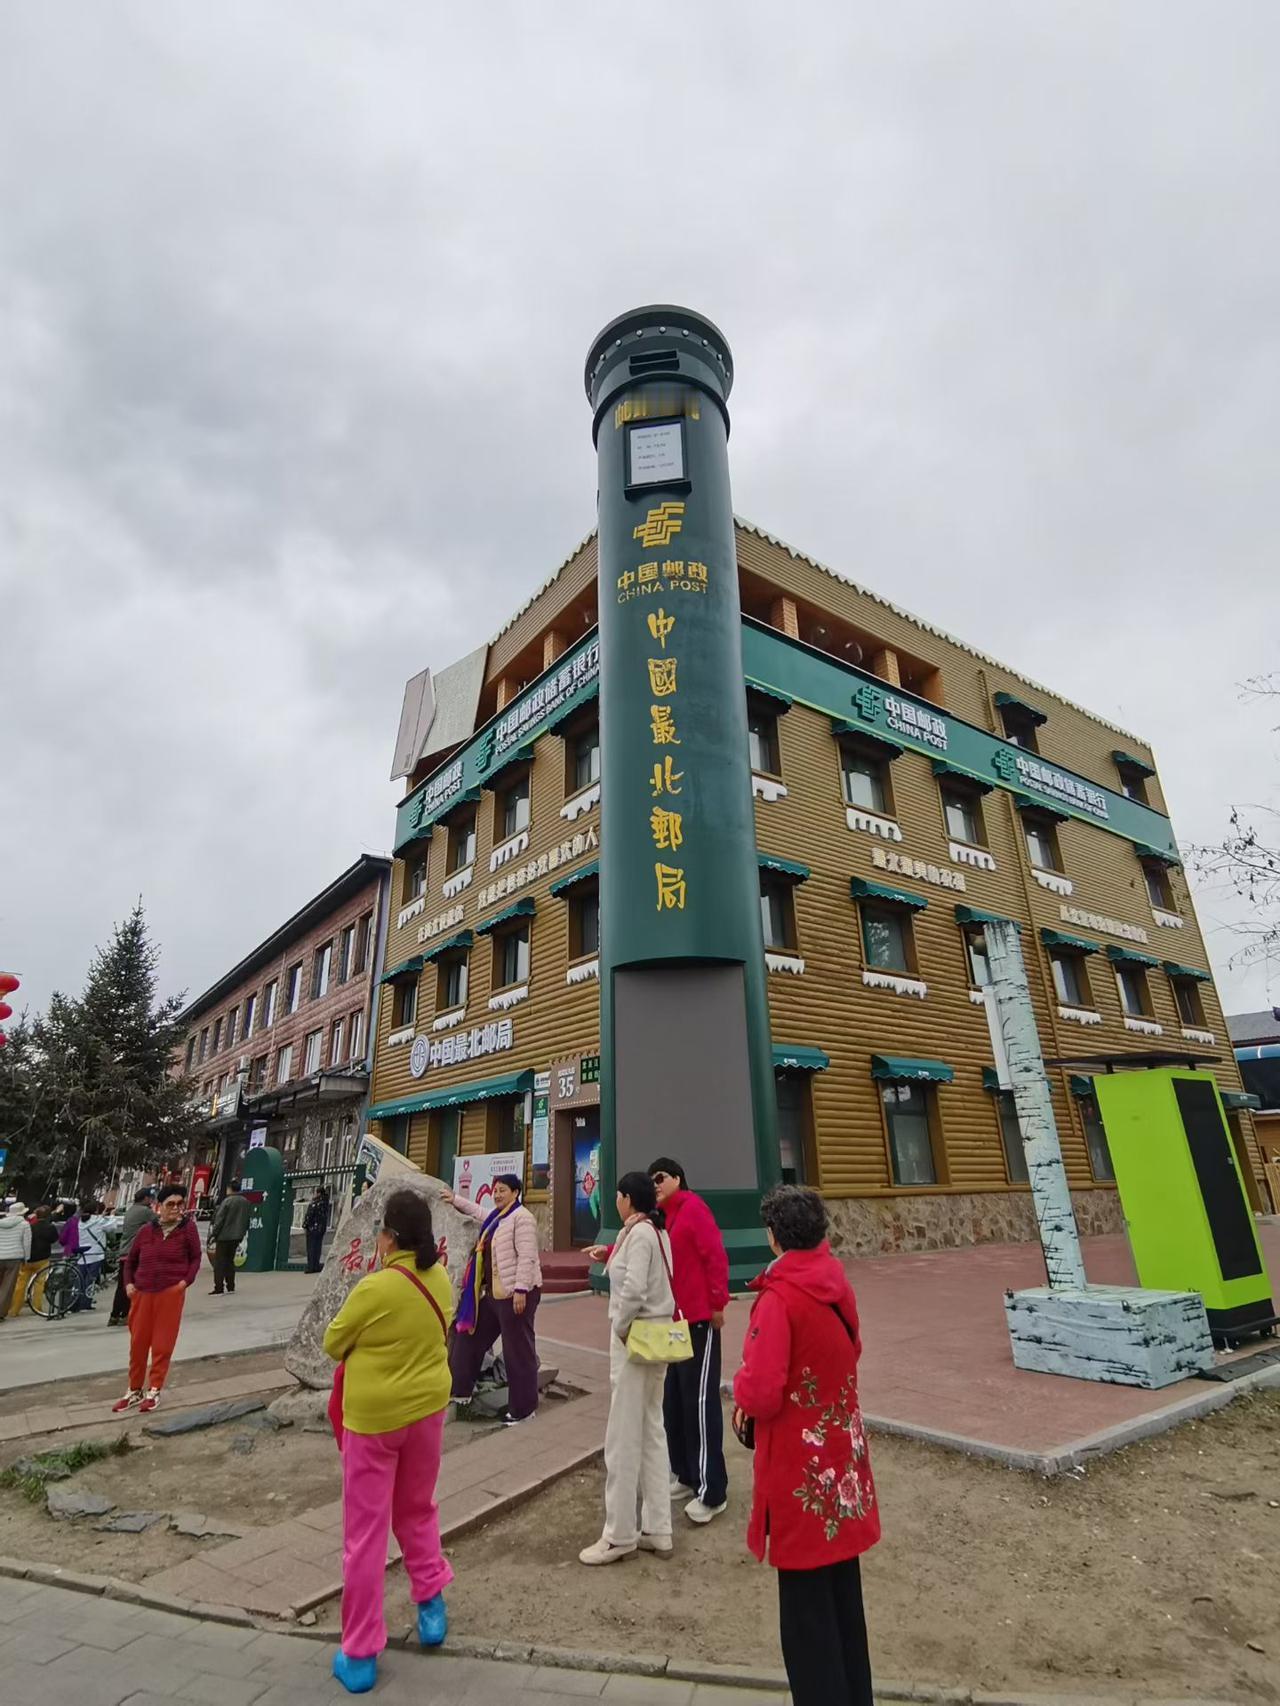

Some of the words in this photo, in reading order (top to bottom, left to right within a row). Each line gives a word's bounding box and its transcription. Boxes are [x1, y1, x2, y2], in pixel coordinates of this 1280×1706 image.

[617, 560, 708, 589] 中国邮政
[617, 581, 664, 603] CHINA
[670, 580, 708, 594] POST
[496, 640, 599, 741] 中国邮政储蓄银行
[566, 684, 577, 697] OF
[885, 696, 947, 740] 中国邮政
[887, 716, 922, 740] CHINA
[923, 731, 948, 750] POST
[425, 761, 463, 803] 中国邮政
[444, 779, 463, 800] POST
[1016, 756, 1107, 810] 中国邮政储蓄银行
[430, 1018, 513, 1068] 中国最北邮局
[558, 1076, 574, 1098] 35
